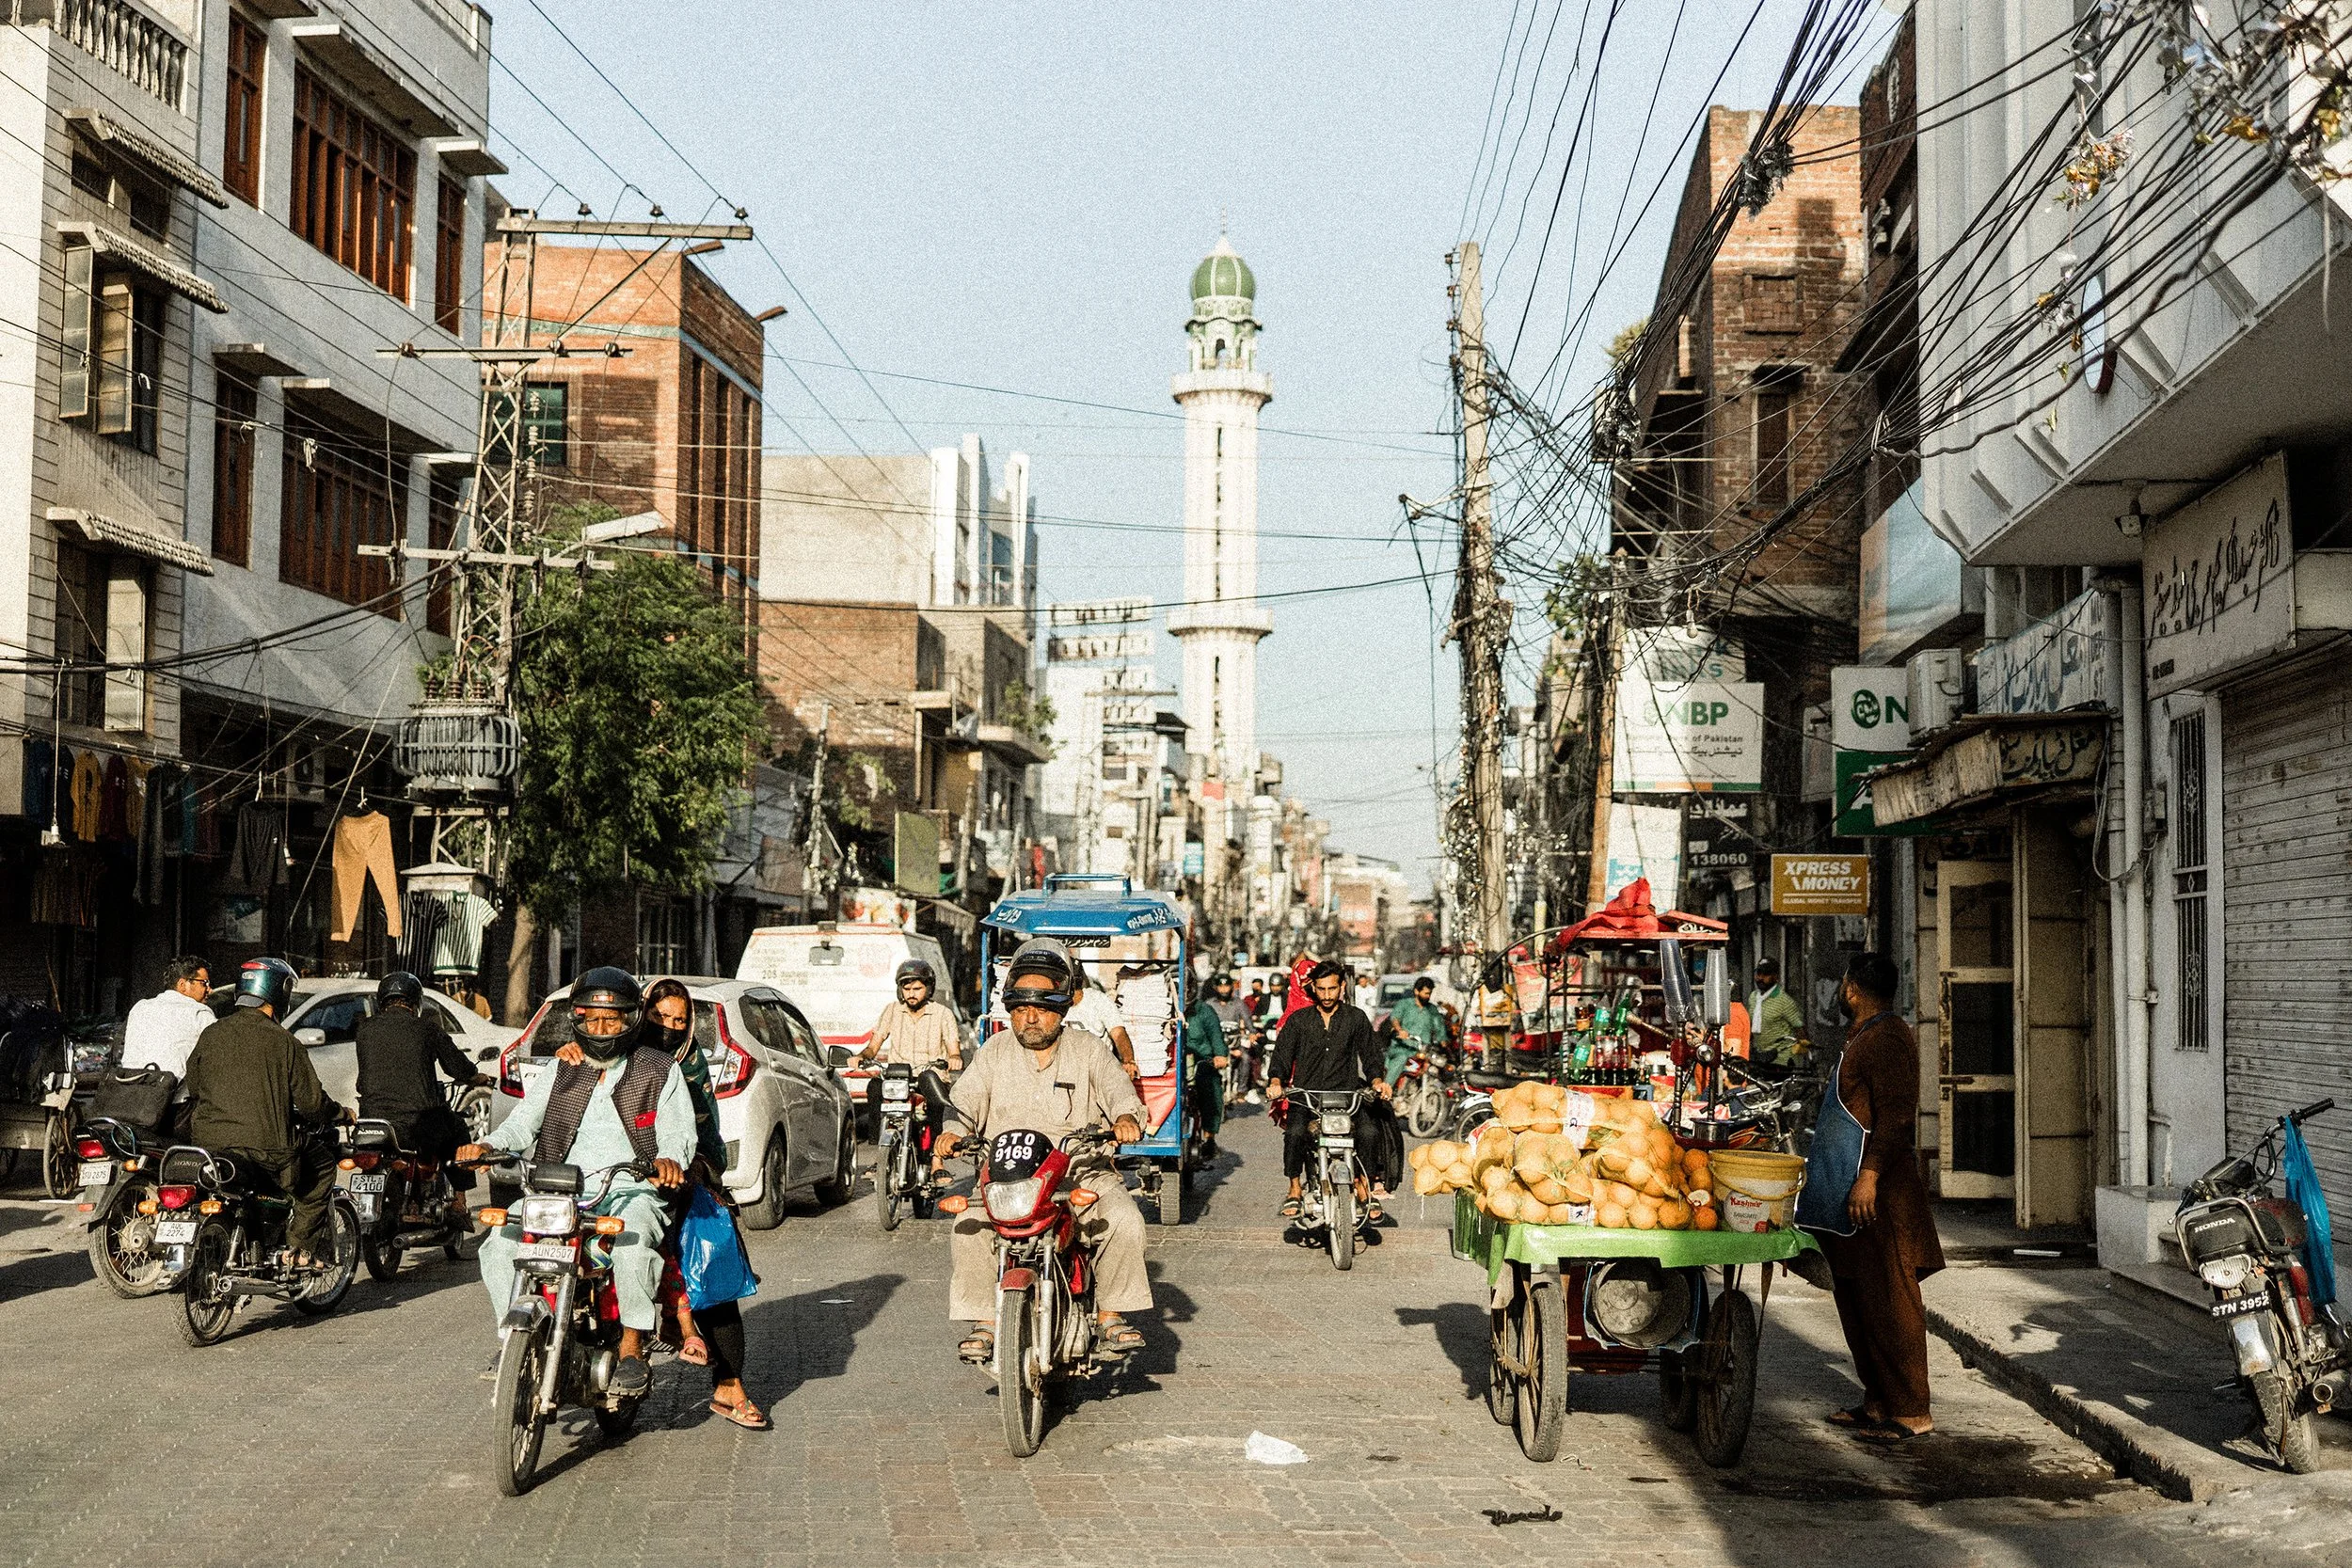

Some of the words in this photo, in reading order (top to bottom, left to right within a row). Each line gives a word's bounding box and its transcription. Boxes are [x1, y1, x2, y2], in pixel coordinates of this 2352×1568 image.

[1664, 701, 1729, 726] NBP
[1691, 853, 1748, 865] 138060
[1784, 862, 1851, 876] XPRESS
[1801, 877, 1861, 891] MONEY
[994, 1145, 1033, 1163] 9169
[356, 1182, 383, 1192] 4100
[2194, 1217, 2236, 1233] HONDA
[2212, 1301, 2237, 1317] STN
[2239, 1296, 2270, 1311] 3952
